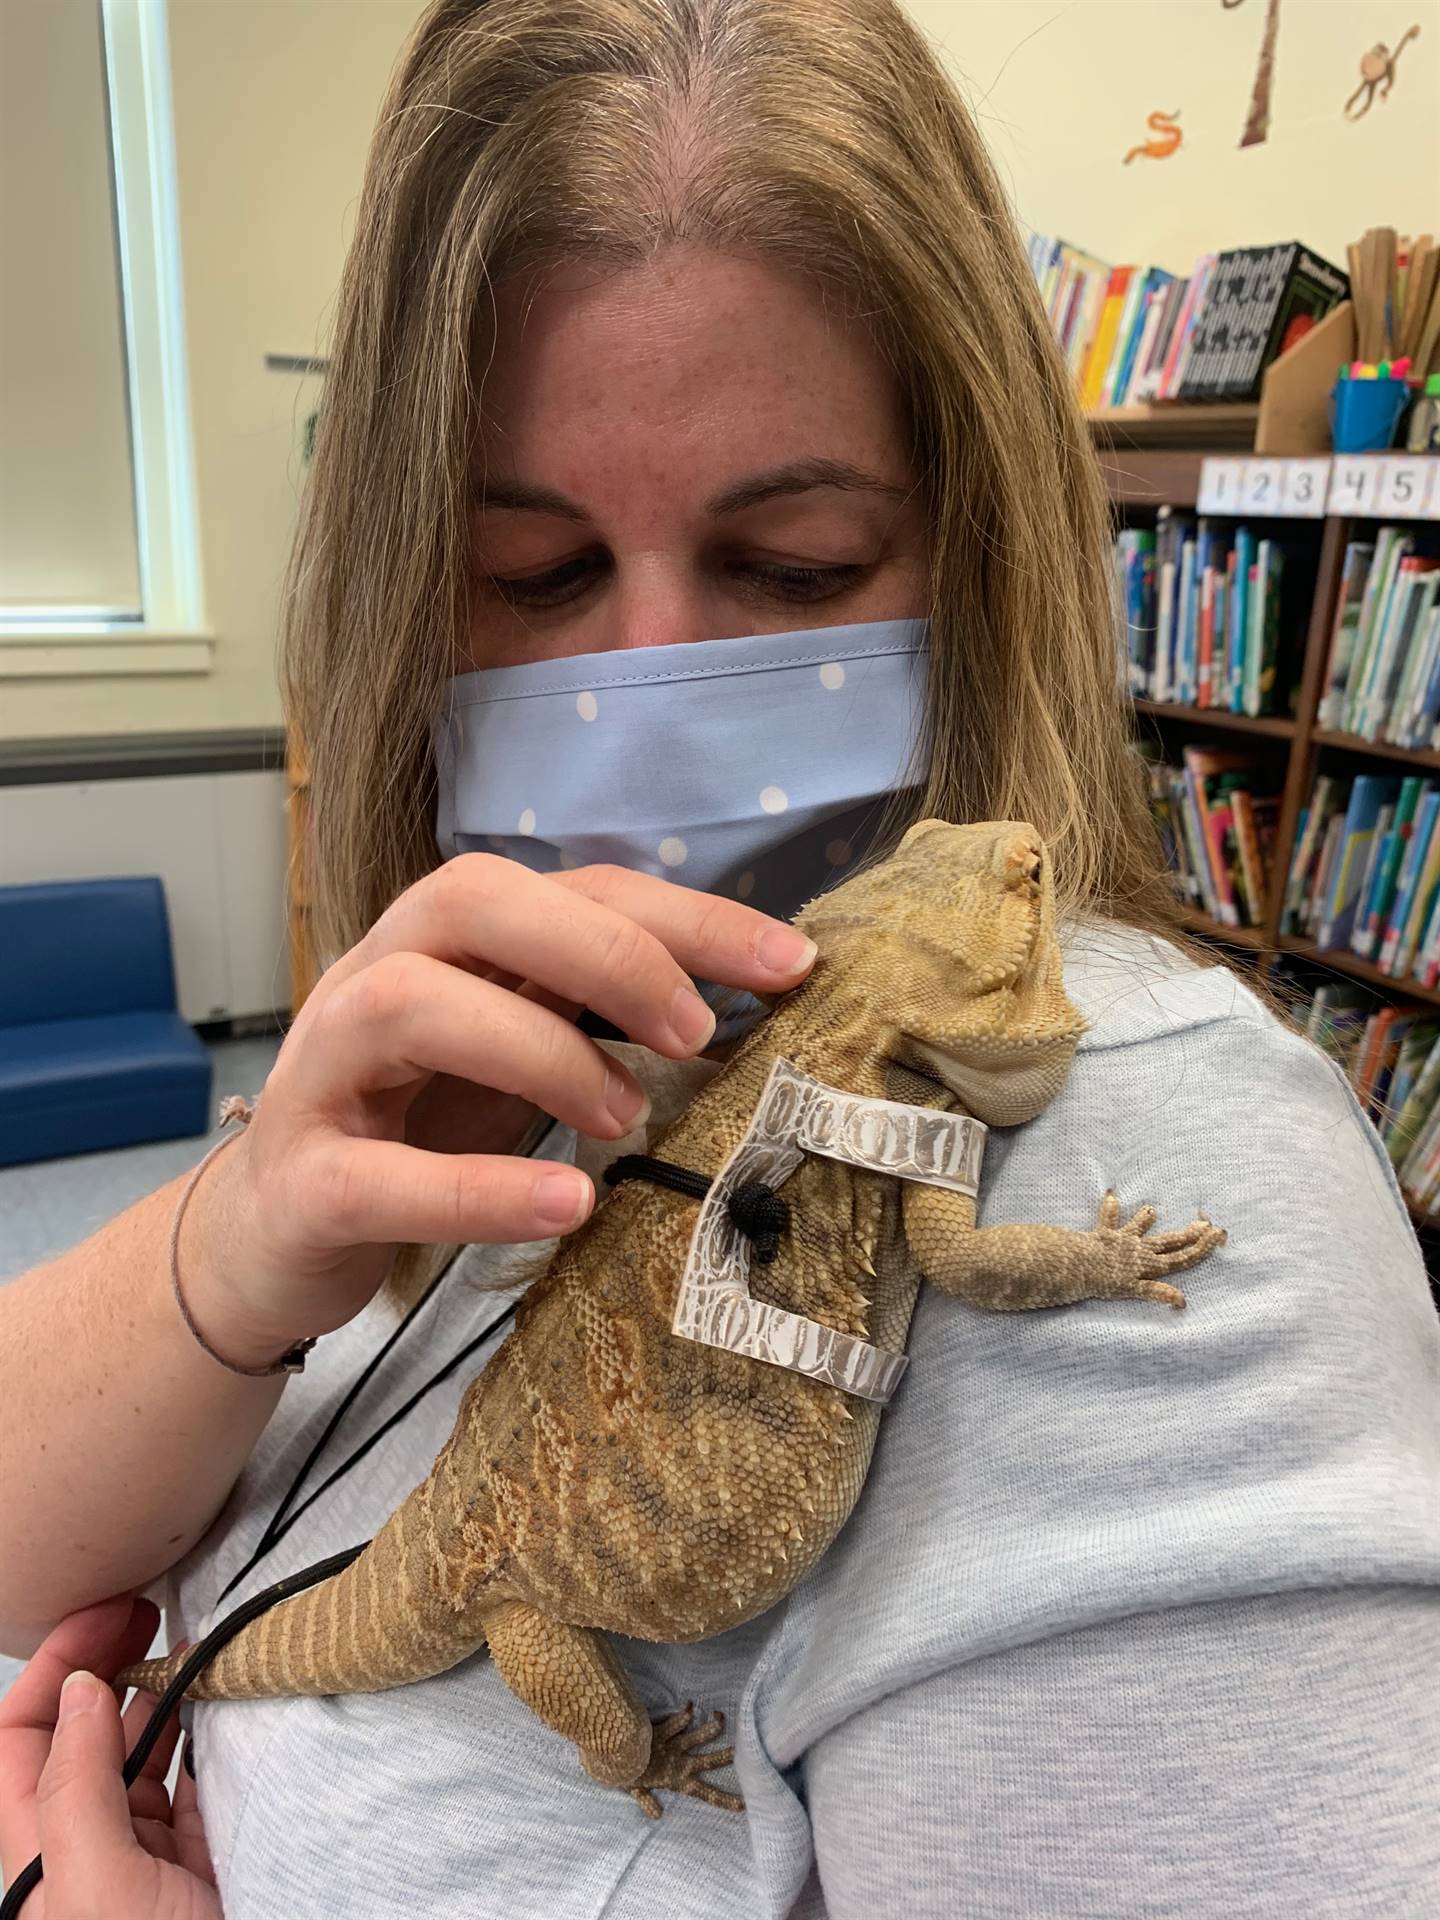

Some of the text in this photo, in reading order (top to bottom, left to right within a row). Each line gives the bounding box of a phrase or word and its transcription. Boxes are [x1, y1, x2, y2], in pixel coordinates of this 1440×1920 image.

[1216, 470, 1415, 503] 1 2 3 4 5
